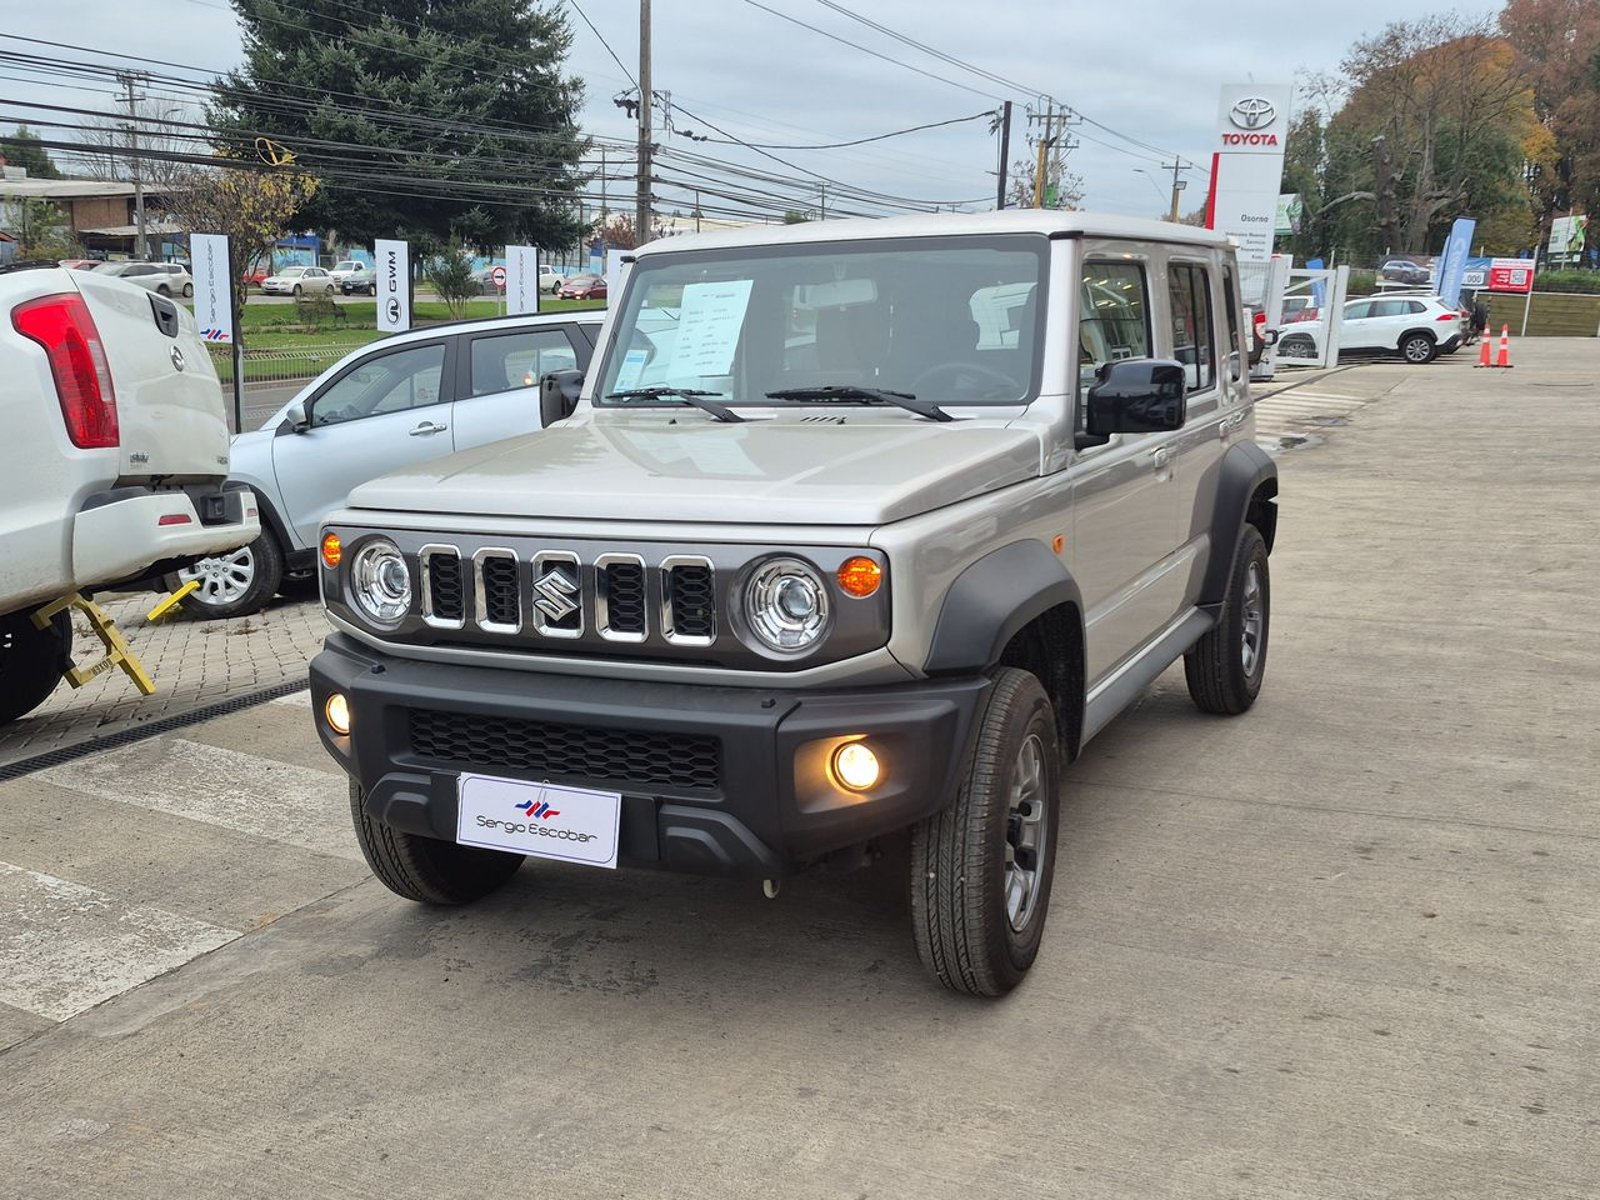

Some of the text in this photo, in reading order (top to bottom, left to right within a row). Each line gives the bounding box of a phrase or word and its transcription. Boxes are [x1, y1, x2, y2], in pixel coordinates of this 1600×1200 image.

[1222, 134, 1278, 146] TOYOTA
[1240, 214, 1269, 222] Osorno
[388, 250, 397, 293] GWM
[528, 823, 598, 843] Escobar
